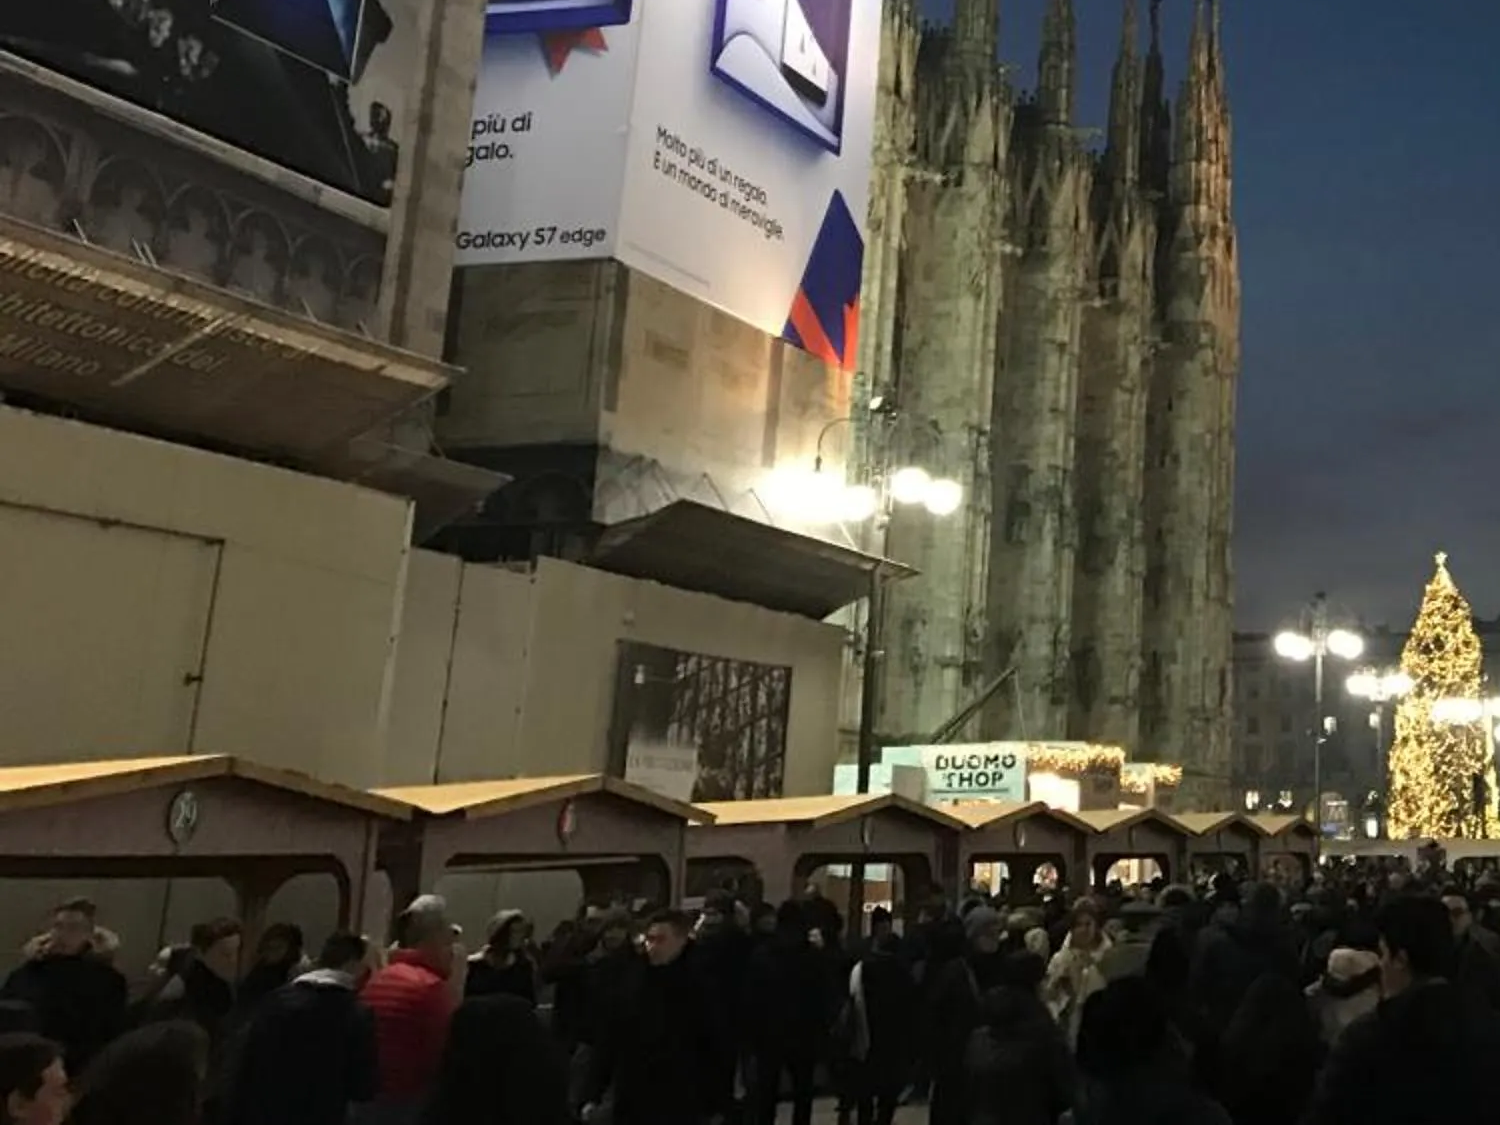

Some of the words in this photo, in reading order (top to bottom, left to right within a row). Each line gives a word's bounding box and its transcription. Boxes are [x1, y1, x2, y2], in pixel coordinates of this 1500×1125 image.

[472, 114, 506, 139] più
[511, 112, 533, 132] di
[656, 126, 687, 158] Molto
[662, 160, 677, 179] un
[677, 169, 716, 203] mondo
[456, 231, 530, 251] Galaxy
[534, 227, 557, 246] S7
[560, 228, 606, 247] edge
[935, 754, 1016, 770] DUOMO
